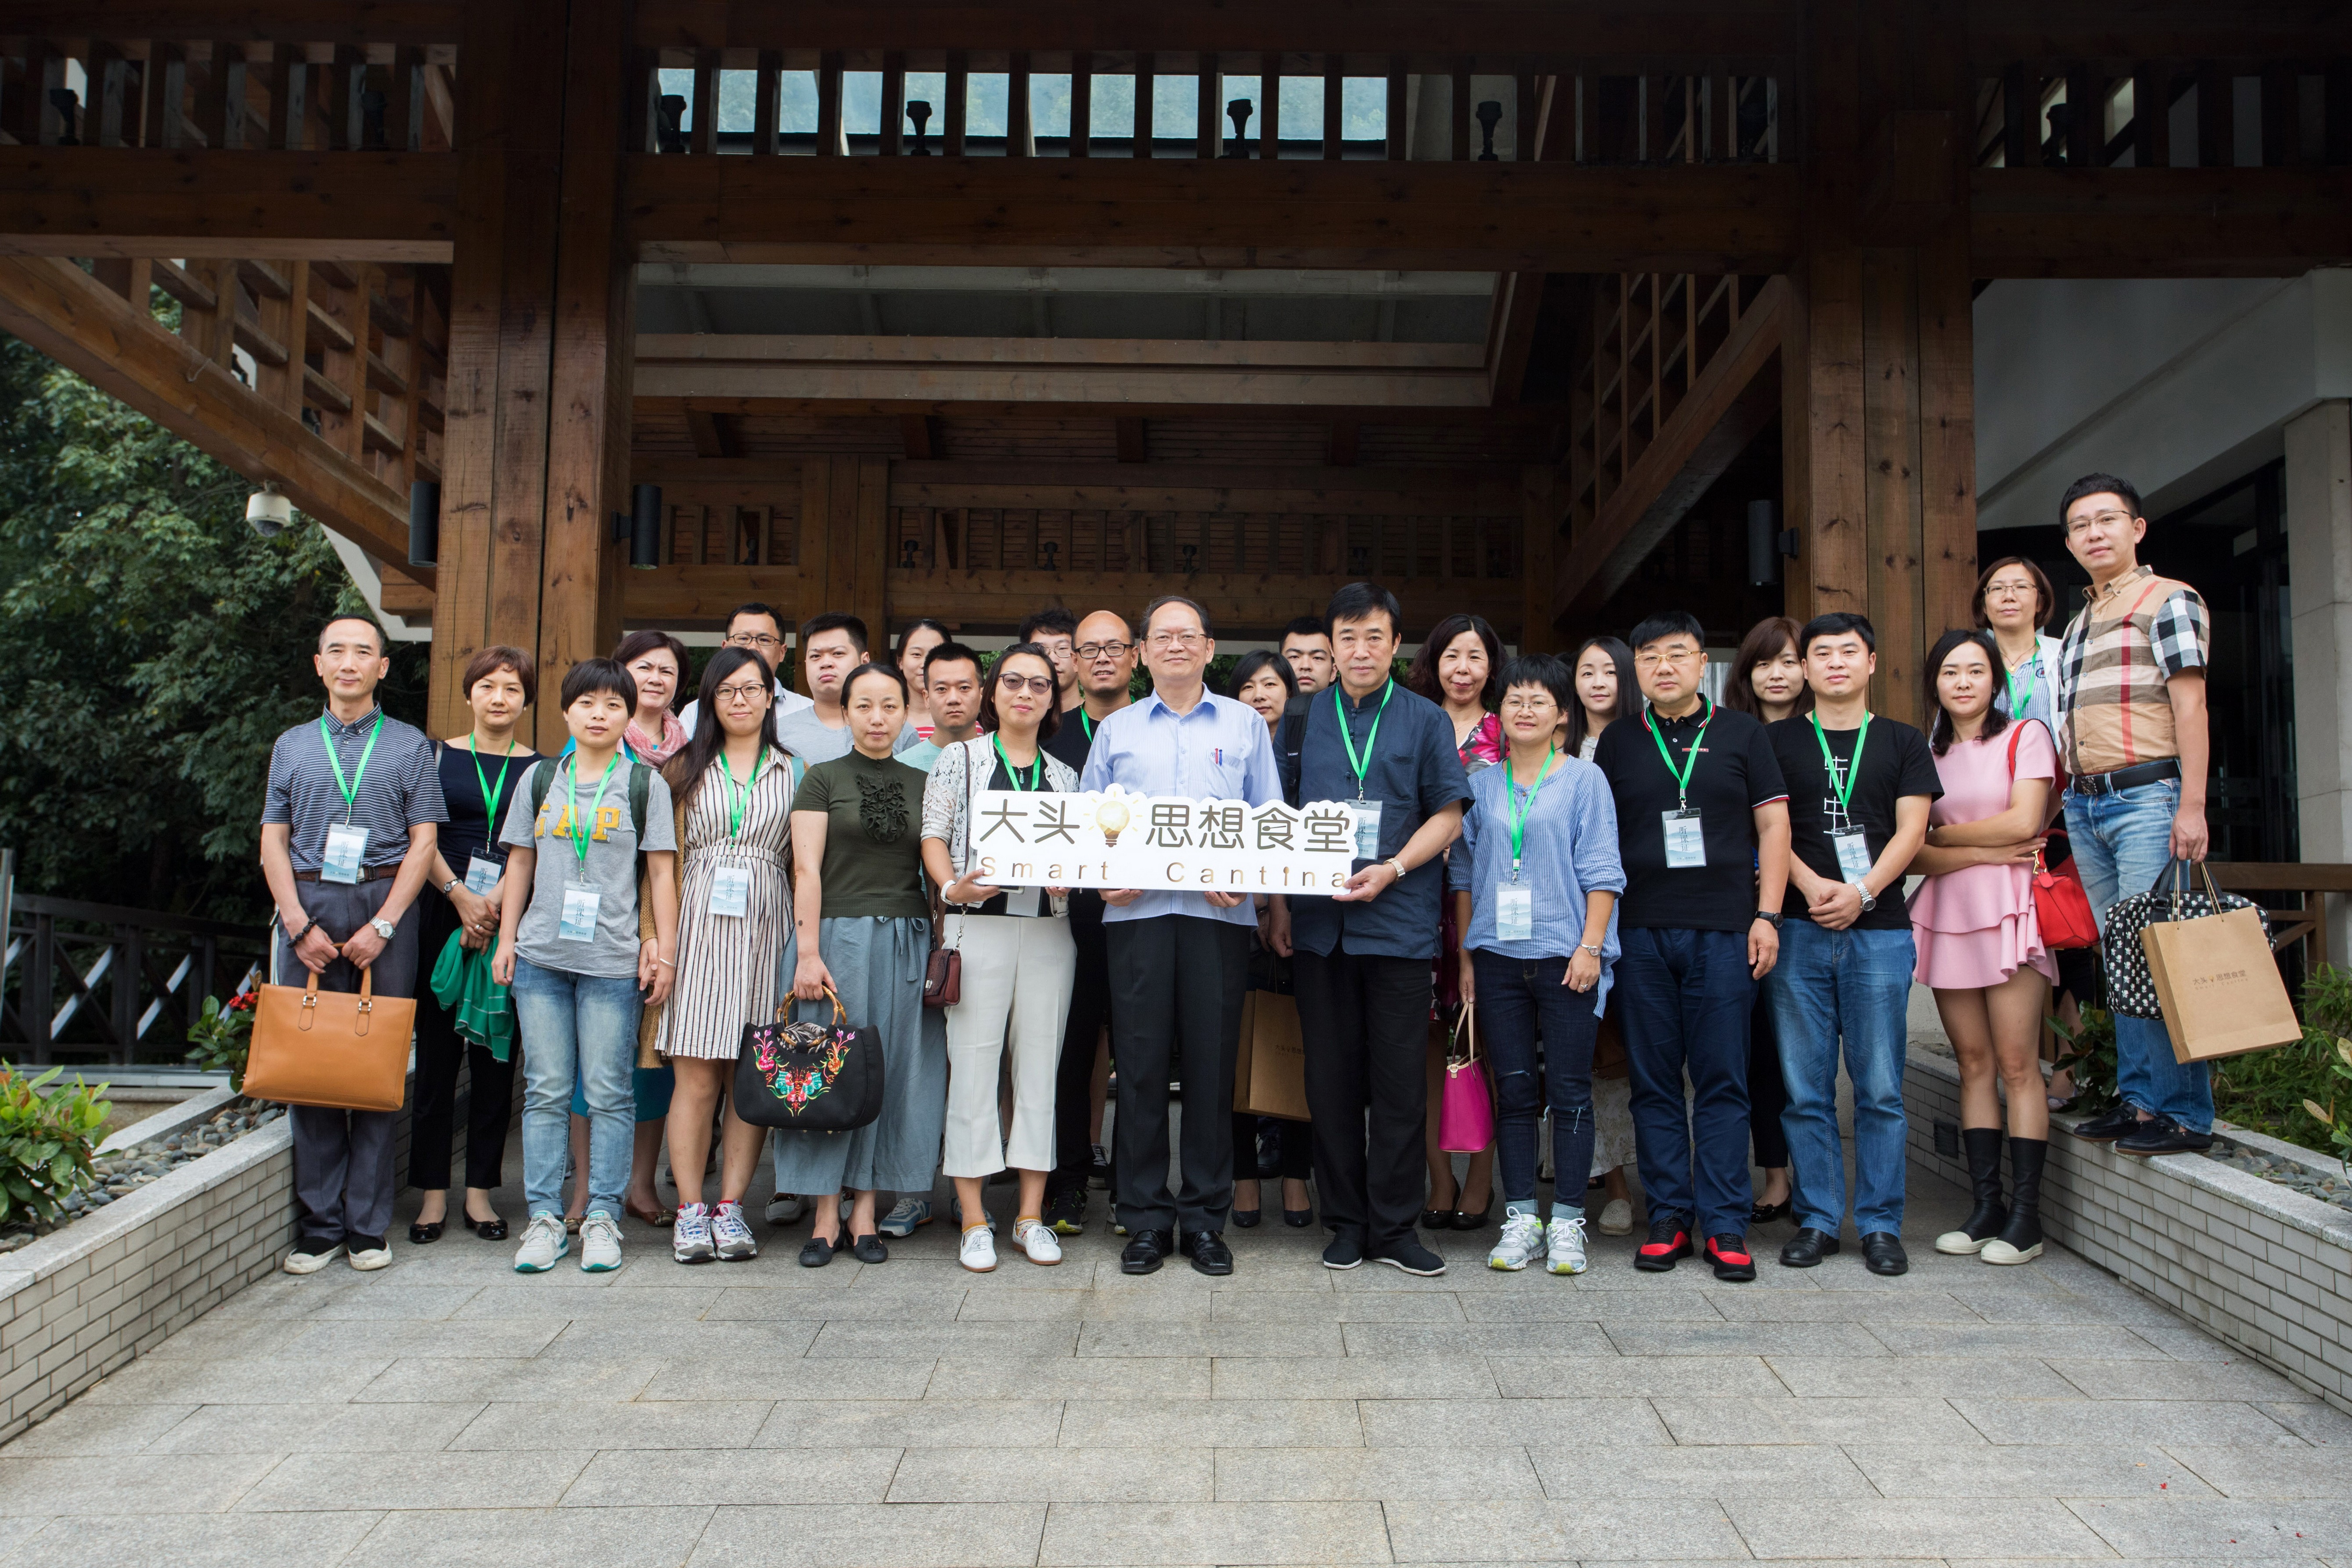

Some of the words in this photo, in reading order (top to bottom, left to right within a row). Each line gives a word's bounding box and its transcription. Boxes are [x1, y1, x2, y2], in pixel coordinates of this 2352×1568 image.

[534, 803, 623, 843] GAP
[979, 798, 1081, 845] 大头
[1145, 804, 1351, 853] 思想食堂
[1357, 817, 1367, 843] 听课证
[1679, 825, 1690, 852] 听课证
[338, 841, 349, 867] 听课证
[1847, 842, 1860, 869] 听课证
[476, 867, 488, 893] 听课证
[980, 857, 1109, 881] Smart
[1166, 862, 1346, 888] Cantina
[725, 875, 735, 901] 听课证
[574, 899, 585, 926] 听课证
[1510, 898, 1519, 925] 听课证
[2192, 977, 2208, 985] 大头
[2215, 969, 2247, 981] 思想食堂
